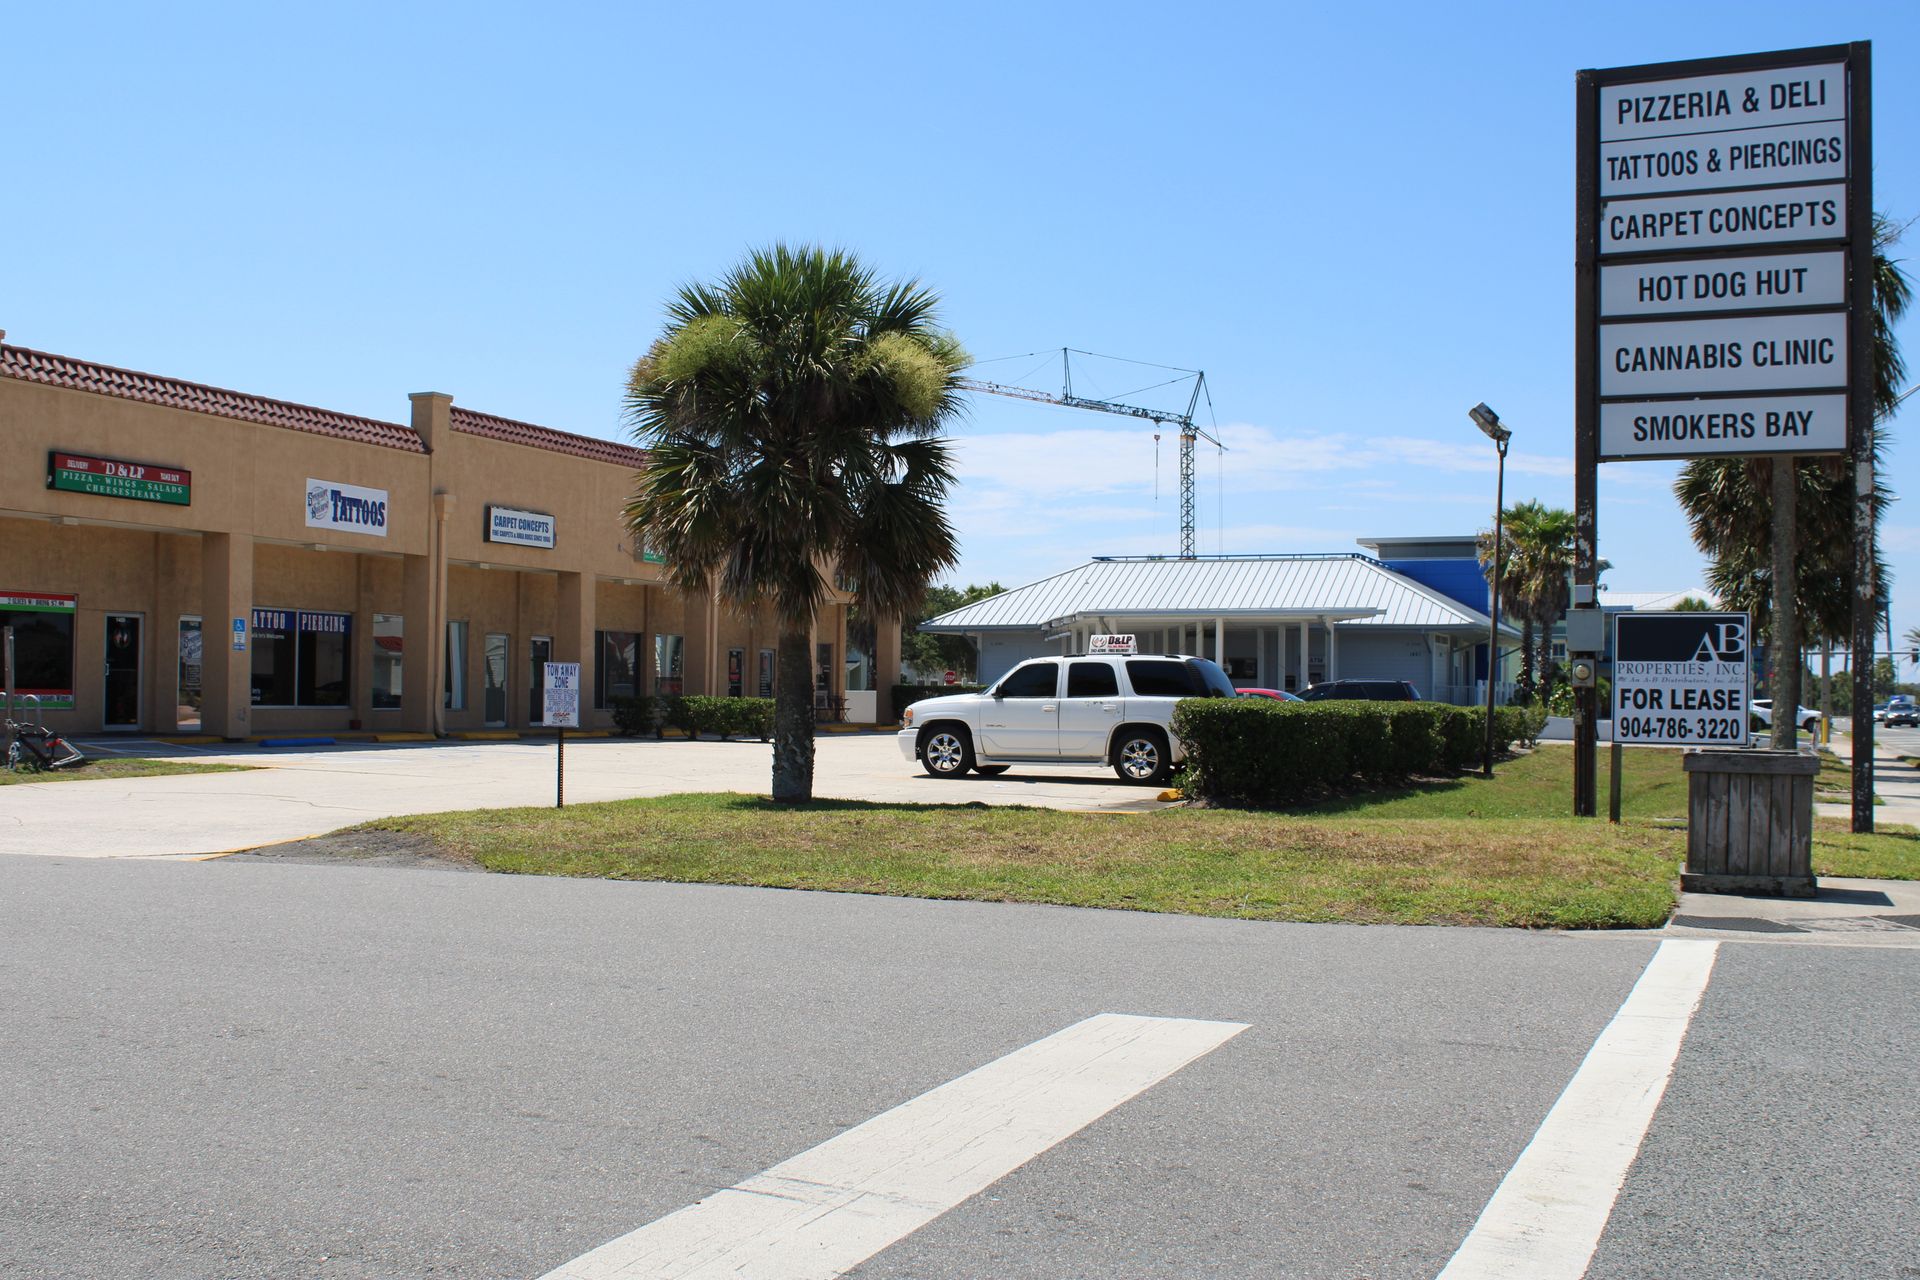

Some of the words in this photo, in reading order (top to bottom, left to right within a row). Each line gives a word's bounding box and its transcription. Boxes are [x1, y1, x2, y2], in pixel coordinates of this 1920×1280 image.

[1617, 90, 1731, 125] PIZZERIA
[1742, 87, 1760, 113] &
[1770, 79, 1826, 111] DELI
[1607, 150, 1698, 181] TATTOOS
[1706, 148, 1721, 173] &
[1730, 136, 1842, 171] PIERCINGS
[1610, 210, 1703, 240] CARPET
[1709, 200, 1837, 233] CONCEPTS
[1639, 275, 1688, 302] HOT
[1694, 271, 1746, 299] DOG
[1756, 268, 1808, 295] HUT
[1615, 342, 1742, 373] CANNABIS
[1752, 337, 1834, 367] CLINIC
[1633, 412, 1755, 441] SMOKERS
[1765, 410, 1814, 437] BAY
[63, 471, 93, 482] PIZZA
[105, 476, 137, 488] WINGS
[147, 482, 183, 494] SALADS
[86, 483, 161, 500] CHEESESTEAKS
[331, 489, 386, 527] TATTOOS
[494, 515, 517, 529] CARPET
[518, 518, 549, 533] CONCEPTS
[252, 611, 286, 629] ATTOO
[302, 614, 345, 632] PIERCING
[547, 664, 559, 676] TOW
[561, 665, 577, 677] AWAY
[1617, 662, 1710, 676] PROPERTIES,
[1716, 663, 1745, 676] INC.
[554, 676, 569, 688] ZONE
[1620, 688, 1663, 710] FOR
[1670, 688, 1741, 711] LEASE
